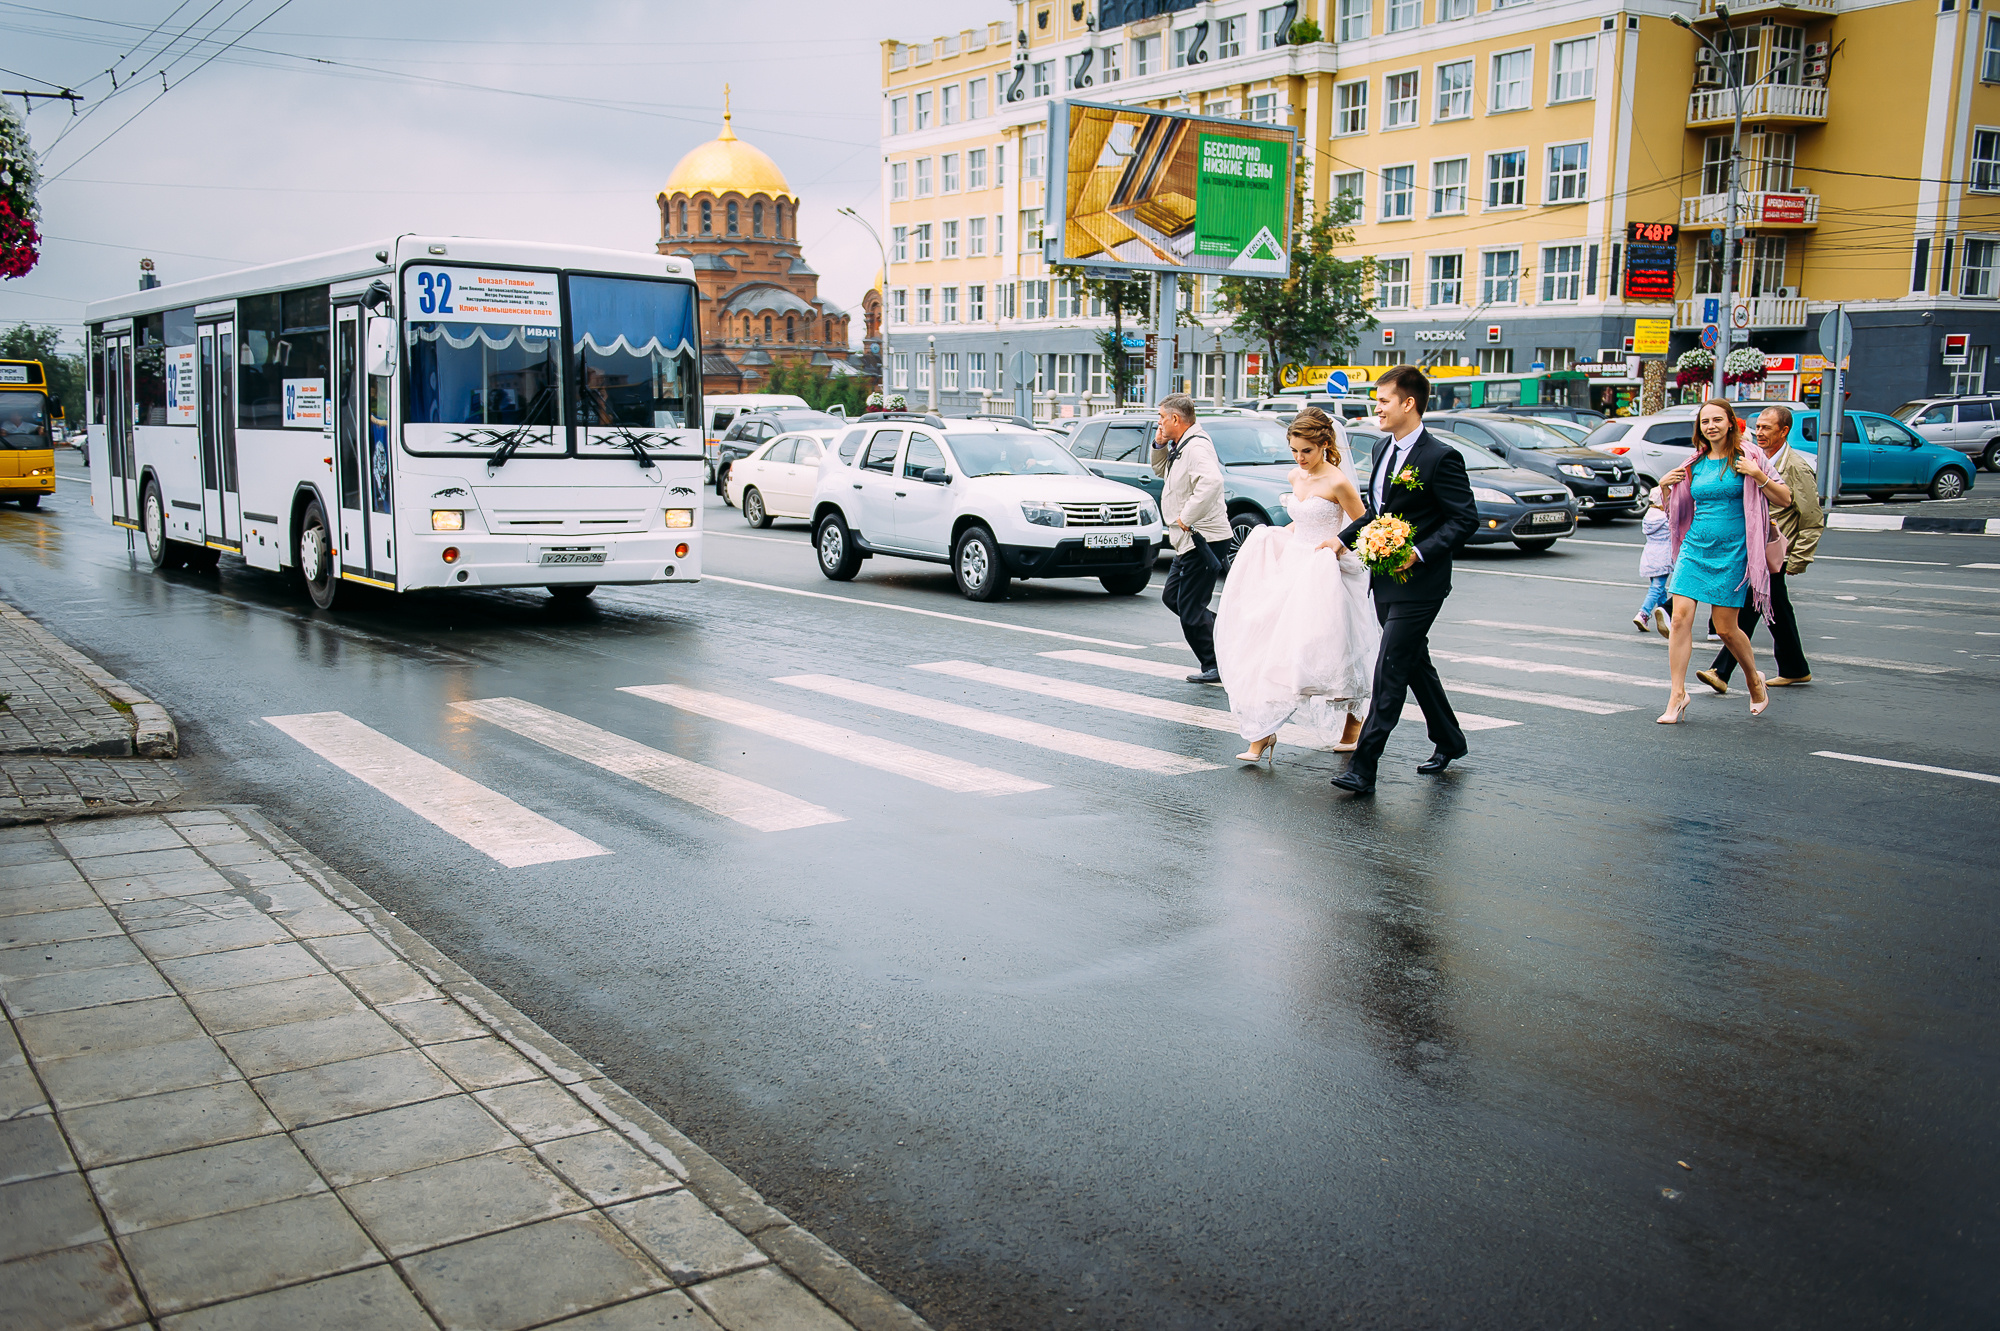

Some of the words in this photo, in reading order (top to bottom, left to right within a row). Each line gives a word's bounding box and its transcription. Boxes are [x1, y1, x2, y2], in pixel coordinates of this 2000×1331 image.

[1203, 141, 1261, 161] БЕССПОРНО
[1203, 157, 1243, 176] НИЗКИЕ
[1245, 162, 1273, 179] ЦЕНЫ
[1245, 235, 1263, 259] LEROY
[478, 276, 535, 287] Вокзал-Главный
[418, 271, 454, 315] 32
[459, 304, 479, 312] Ключ
[483, 304, 532, 315] Камышенское
[533, 308, 553, 316] плато
[526, 328, 557, 338] ИВАН
[1415, 330, 1466, 341] РОСБАНК
[1575, 364, 1602, 373] COFFEE
[1602, 364, 1627, 373] BEANS
[168, 363, 178, 408] 32
[287, 384, 295, 420] 32
[592, 553, 602, 561] 96
